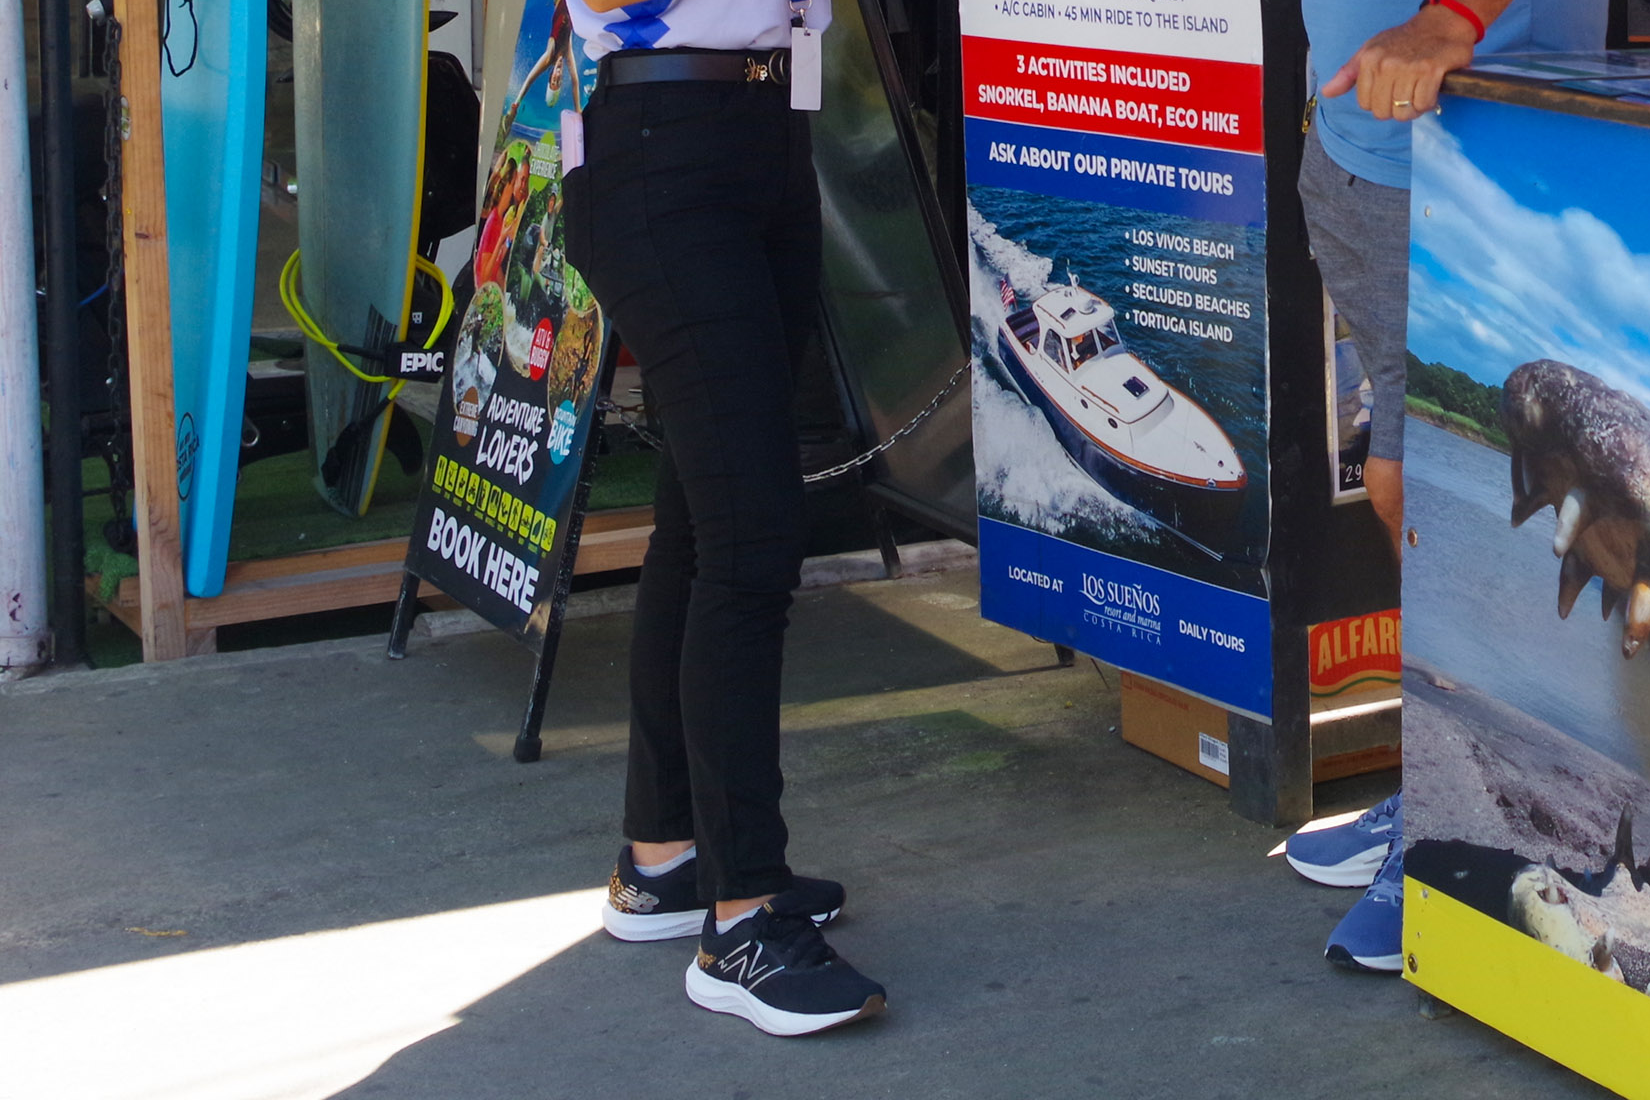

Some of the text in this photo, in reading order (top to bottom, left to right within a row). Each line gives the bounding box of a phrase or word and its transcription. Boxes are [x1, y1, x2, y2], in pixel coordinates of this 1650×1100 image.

[1002, 0, 1229, 34] A/C CABIN MIN RIDE TO THE ISLAND
[1028, 56, 1191, 92] ACTIVITIES INCLUDED
[1046, 92, 1240, 135] BANANA ECO HIKE
[989, 142, 1234, 196] ASK ABOUT OUR PRIVATE TOURS
[1132, 229, 1235, 261] LOS VIVOS BEACH
[1132, 256, 1217, 285] SUNSET TOURS
[1132, 283, 1251, 319] SECLUDED BEACHES
[1133, 309, 1233, 343] TORTUGA ISLAND
[400, 352, 444, 373] EPIC
[486, 393, 546, 436] ADVENTURE
[476, 426, 539, 485] LOVERS
[548, 420, 576, 457] BIKE
[427, 507, 487, 581] BOOK
[483, 546, 540, 614] HERE
[1008, 566, 1064, 593] LOCATED AT
[1107, 582, 1161, 617] SUEÑOS
[1138, 615, 1161, 631] marina
[1179, 620, 1245, 653] DAILY TOURS
